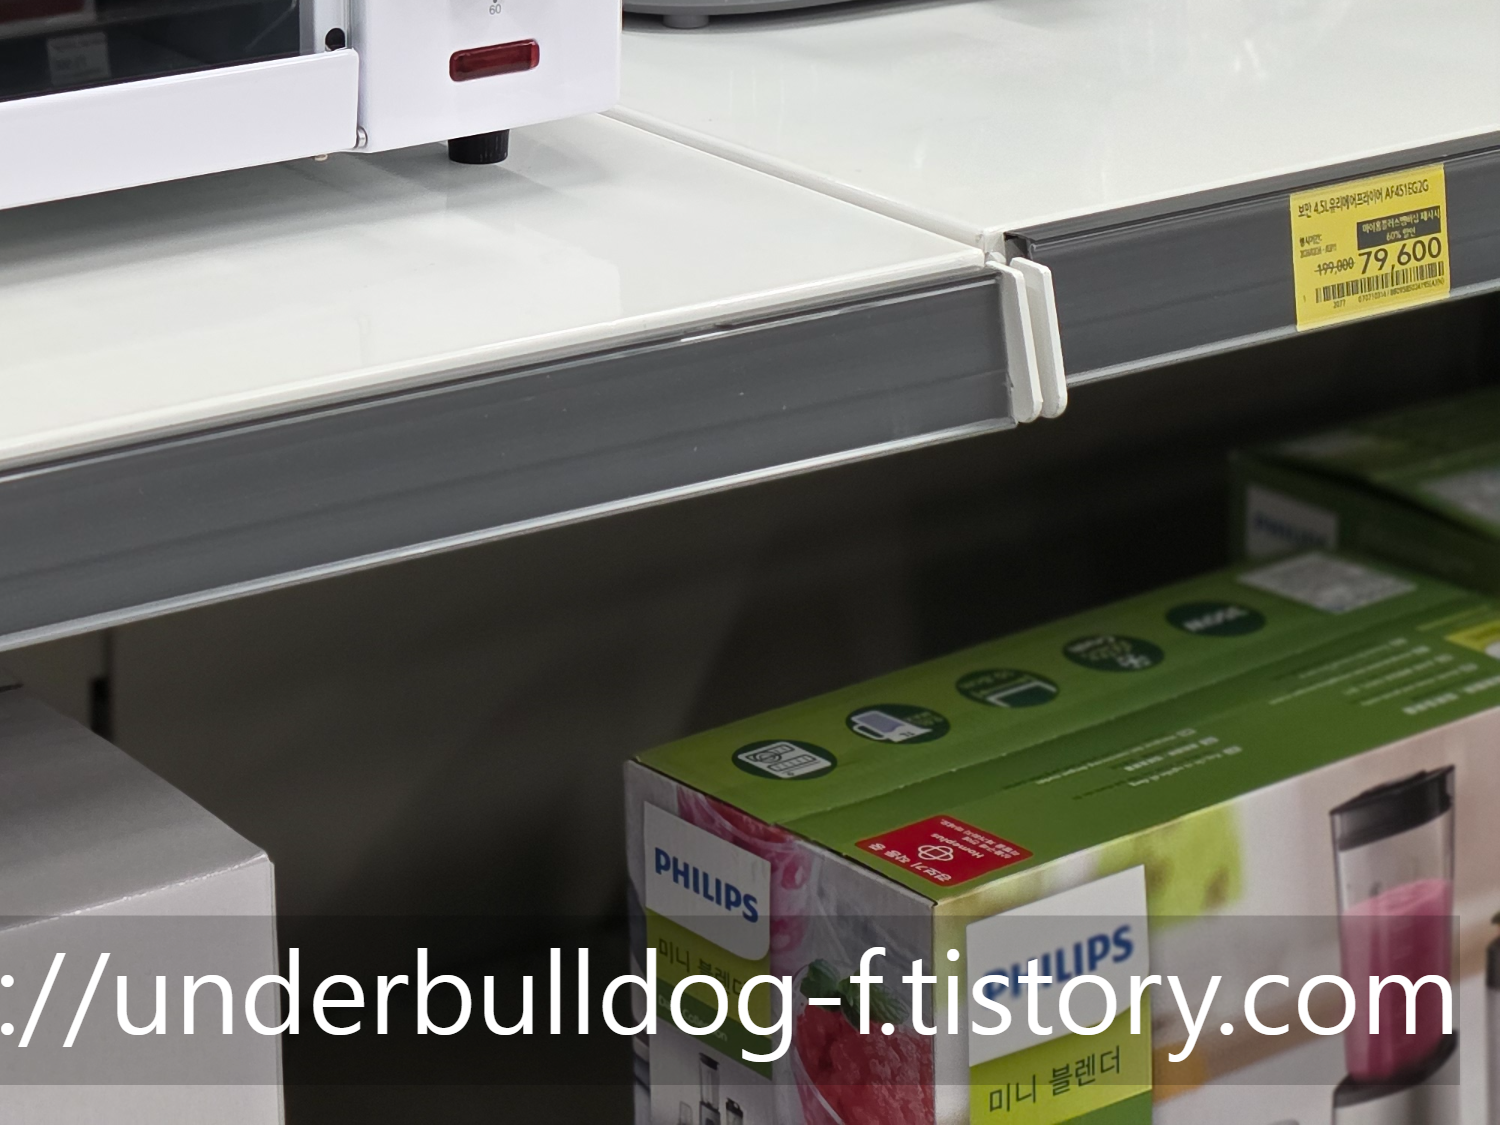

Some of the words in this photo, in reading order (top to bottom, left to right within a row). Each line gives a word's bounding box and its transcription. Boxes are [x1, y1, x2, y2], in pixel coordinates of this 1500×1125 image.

[489, 3, 502, 15] 60
[1298, 202, 1312, 218] 보만
[1316, 256, 1355, 276] 199,000
[1358, 236, 1442, 277] 79,600
[930, 832, 985, 859] Homeplus
[654, 846, 759, 924] PHILIPS
[910, 861, 952, 883] 경보기
[658, 937, 691, 974] 미니
[989, 1074, 1036, 1113] 미니
[1049, 1044, 1120, 1097] 블렌더
